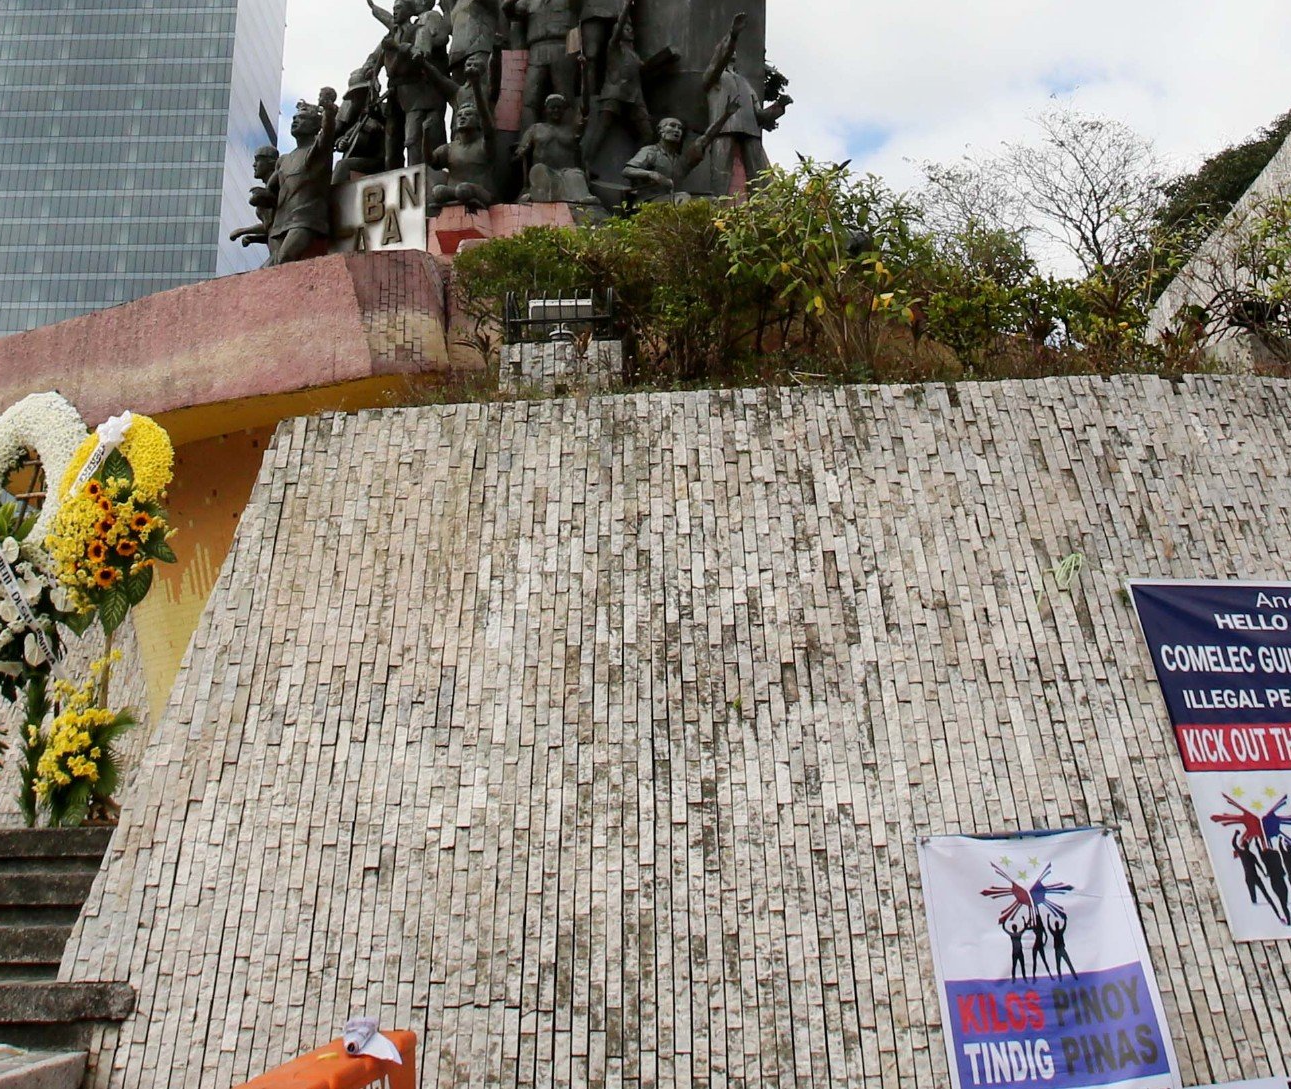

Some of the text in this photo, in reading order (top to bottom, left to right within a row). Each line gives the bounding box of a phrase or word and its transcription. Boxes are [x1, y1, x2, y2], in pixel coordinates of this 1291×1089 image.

[1213, 613, 1288, 631] HELLO
[1161, 645, 1256, 674] COMELEC
[1183, 689, 1265, 710] ILLEGAL
[1182, 728, 1230, 764] KICK
[1233, 729, 1267, 763] OUT
[957, 975, 1141, 1034] KILOS PINOY
[963, 1024, 1159, 1086] TINDIG PINAS
